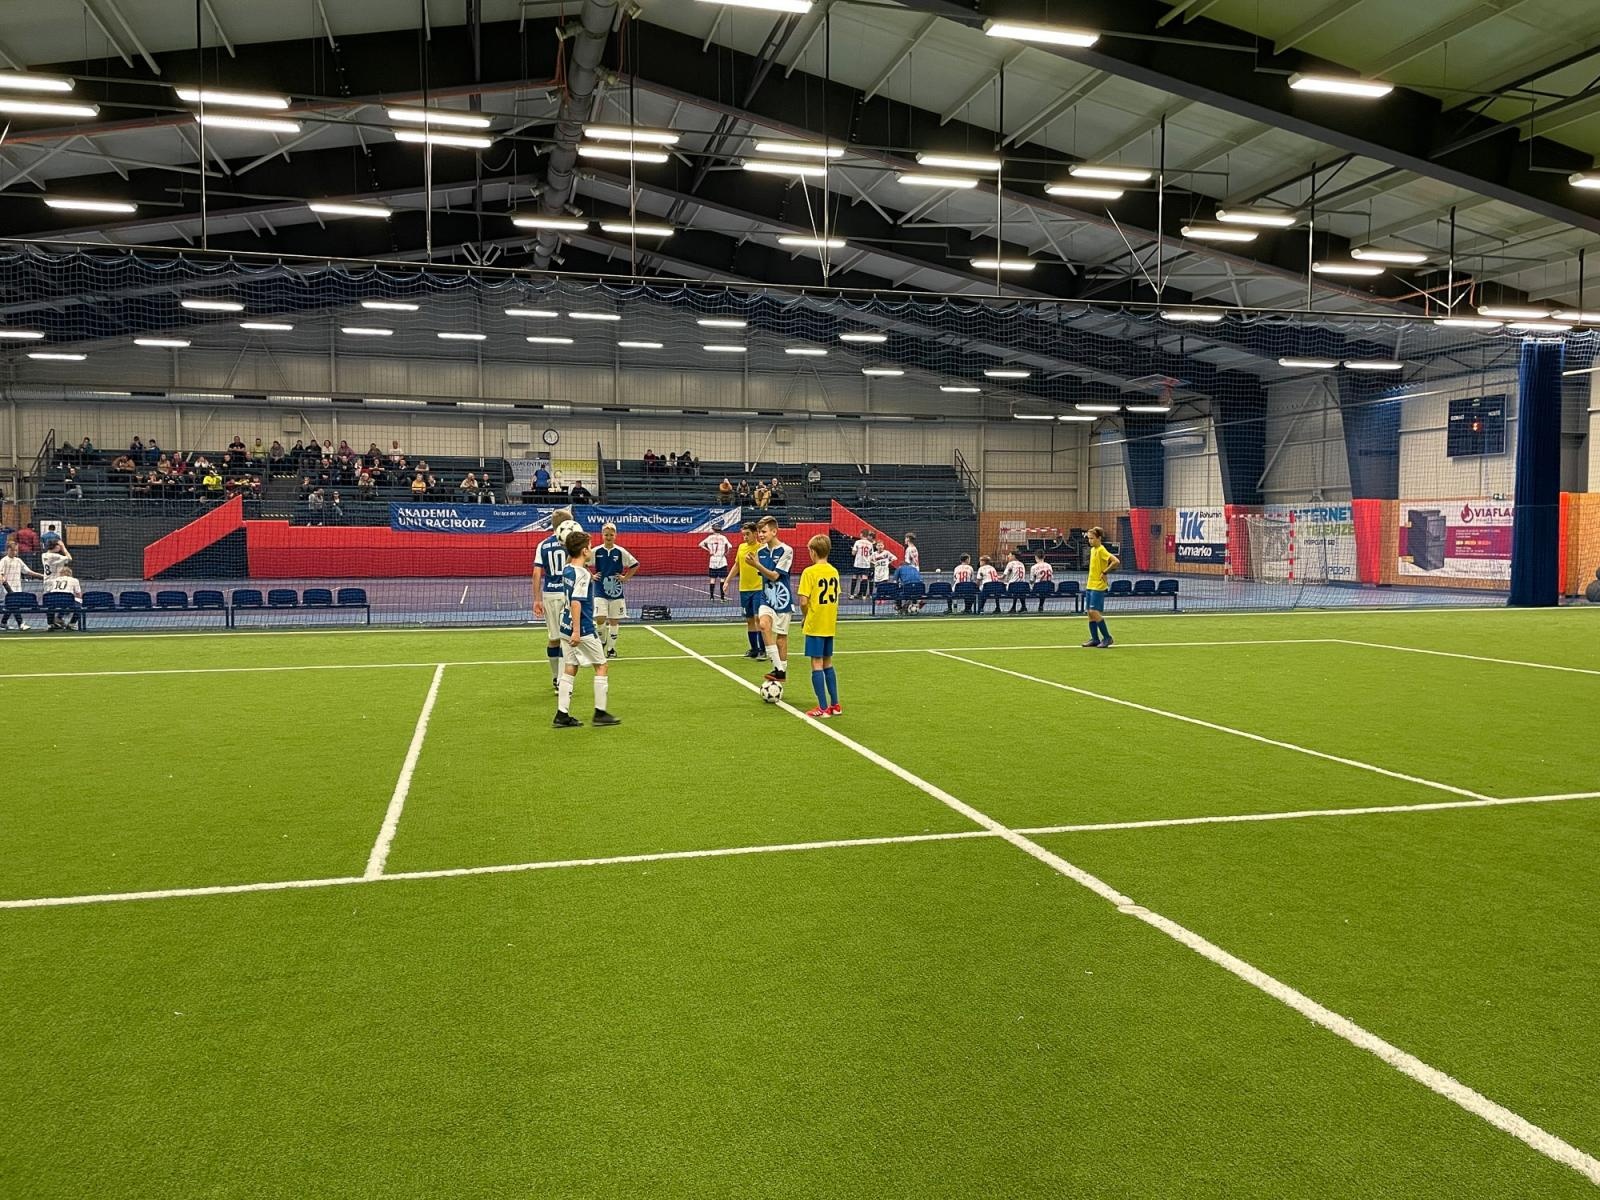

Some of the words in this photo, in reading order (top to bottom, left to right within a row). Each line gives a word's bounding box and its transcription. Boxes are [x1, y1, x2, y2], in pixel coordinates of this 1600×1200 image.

[398, 507, 459, 518] AKADEMIA
[1474, 508, 1514, 518] VIAFLA
[425, 517, 487, 528] RACIBÓRZ
[547, 549, 566, 576] 10
[818, 577, 838, 605] 23
